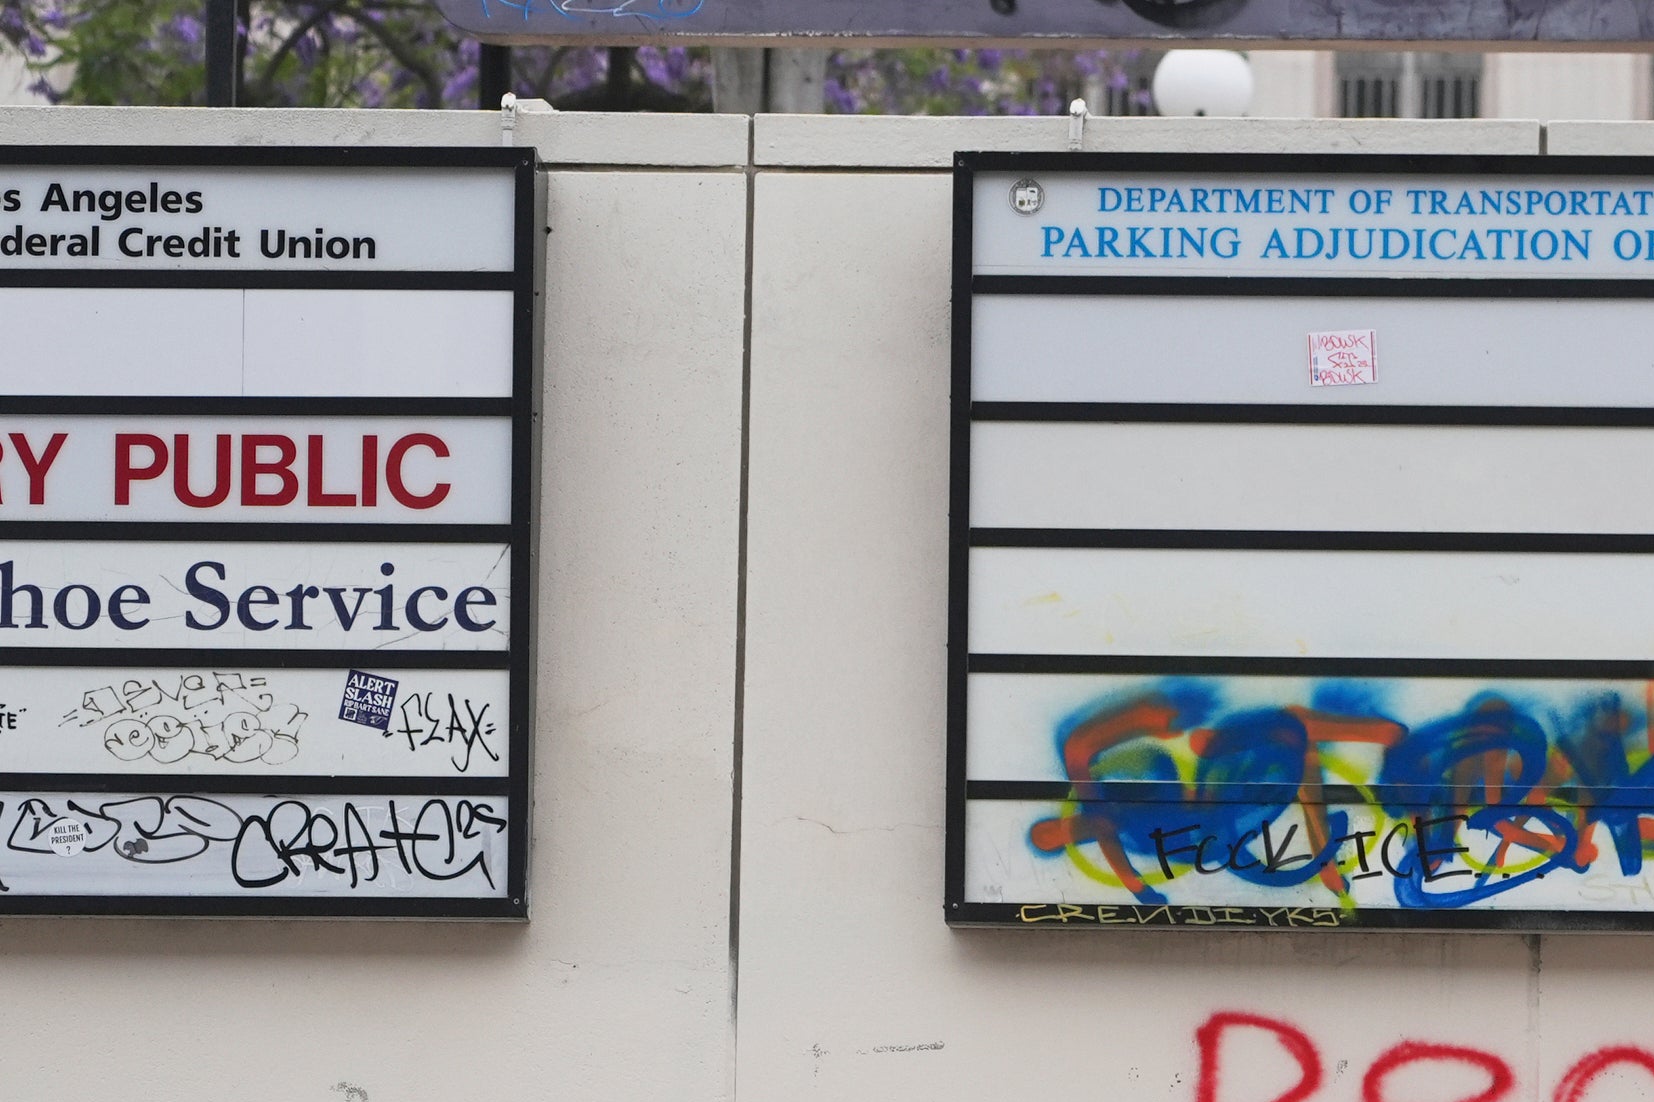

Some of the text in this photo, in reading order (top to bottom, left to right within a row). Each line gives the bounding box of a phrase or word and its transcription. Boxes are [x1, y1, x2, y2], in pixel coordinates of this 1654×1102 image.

[40, 182, 203, 221] Angeles
[1098, 187, 1335, 214] DEPARTMENT
[1349, 189, 1393, 215] OF
[118, 227, 240, 259] Credit
[260, 228, 376, 260] Union
[1041, 226, 1241, 260] PARKING
[1259, 227, 1593, 262] ADJUDICATION
[0, 432, 451, 510] Y PUBLIC
[0, 560, 498, 633] hoe Service
[344, 686, 393, 709] SLASH
[348, 673, 396, 696] ALERT
[51, 833, 84, 844] PRESIDENT
[53, 824, 80, 834] KILL THE
